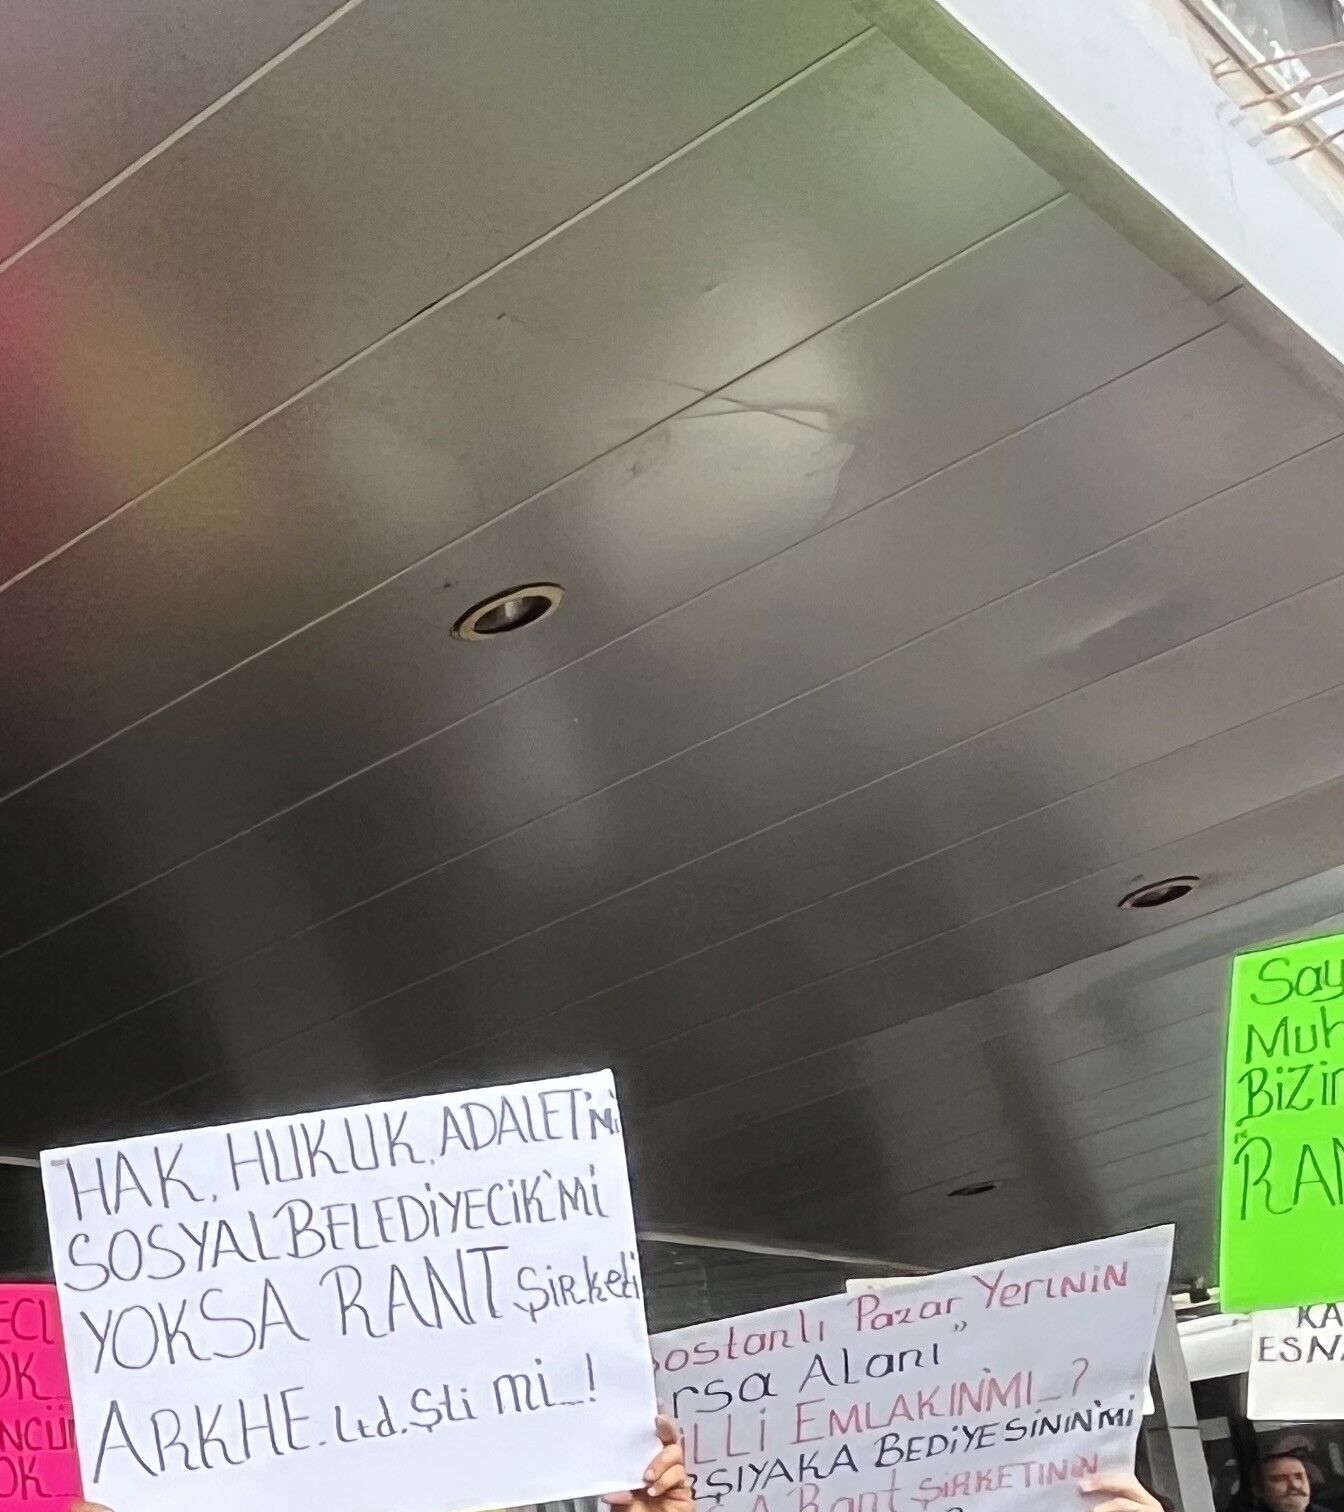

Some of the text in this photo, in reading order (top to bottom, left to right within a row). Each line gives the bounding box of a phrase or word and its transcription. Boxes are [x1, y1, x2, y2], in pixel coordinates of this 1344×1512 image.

[64, 1211, 280, 1291] SOSYAL
[80, 1278, 310, 1373] YOKSA
[319, 1246, 509, 1338] RANT
[653, 1309, 824, 1372] ostanlı
[847, 1294, 962, 1332] Pazar
[1258, 1334, 1344, 1363] ESN
